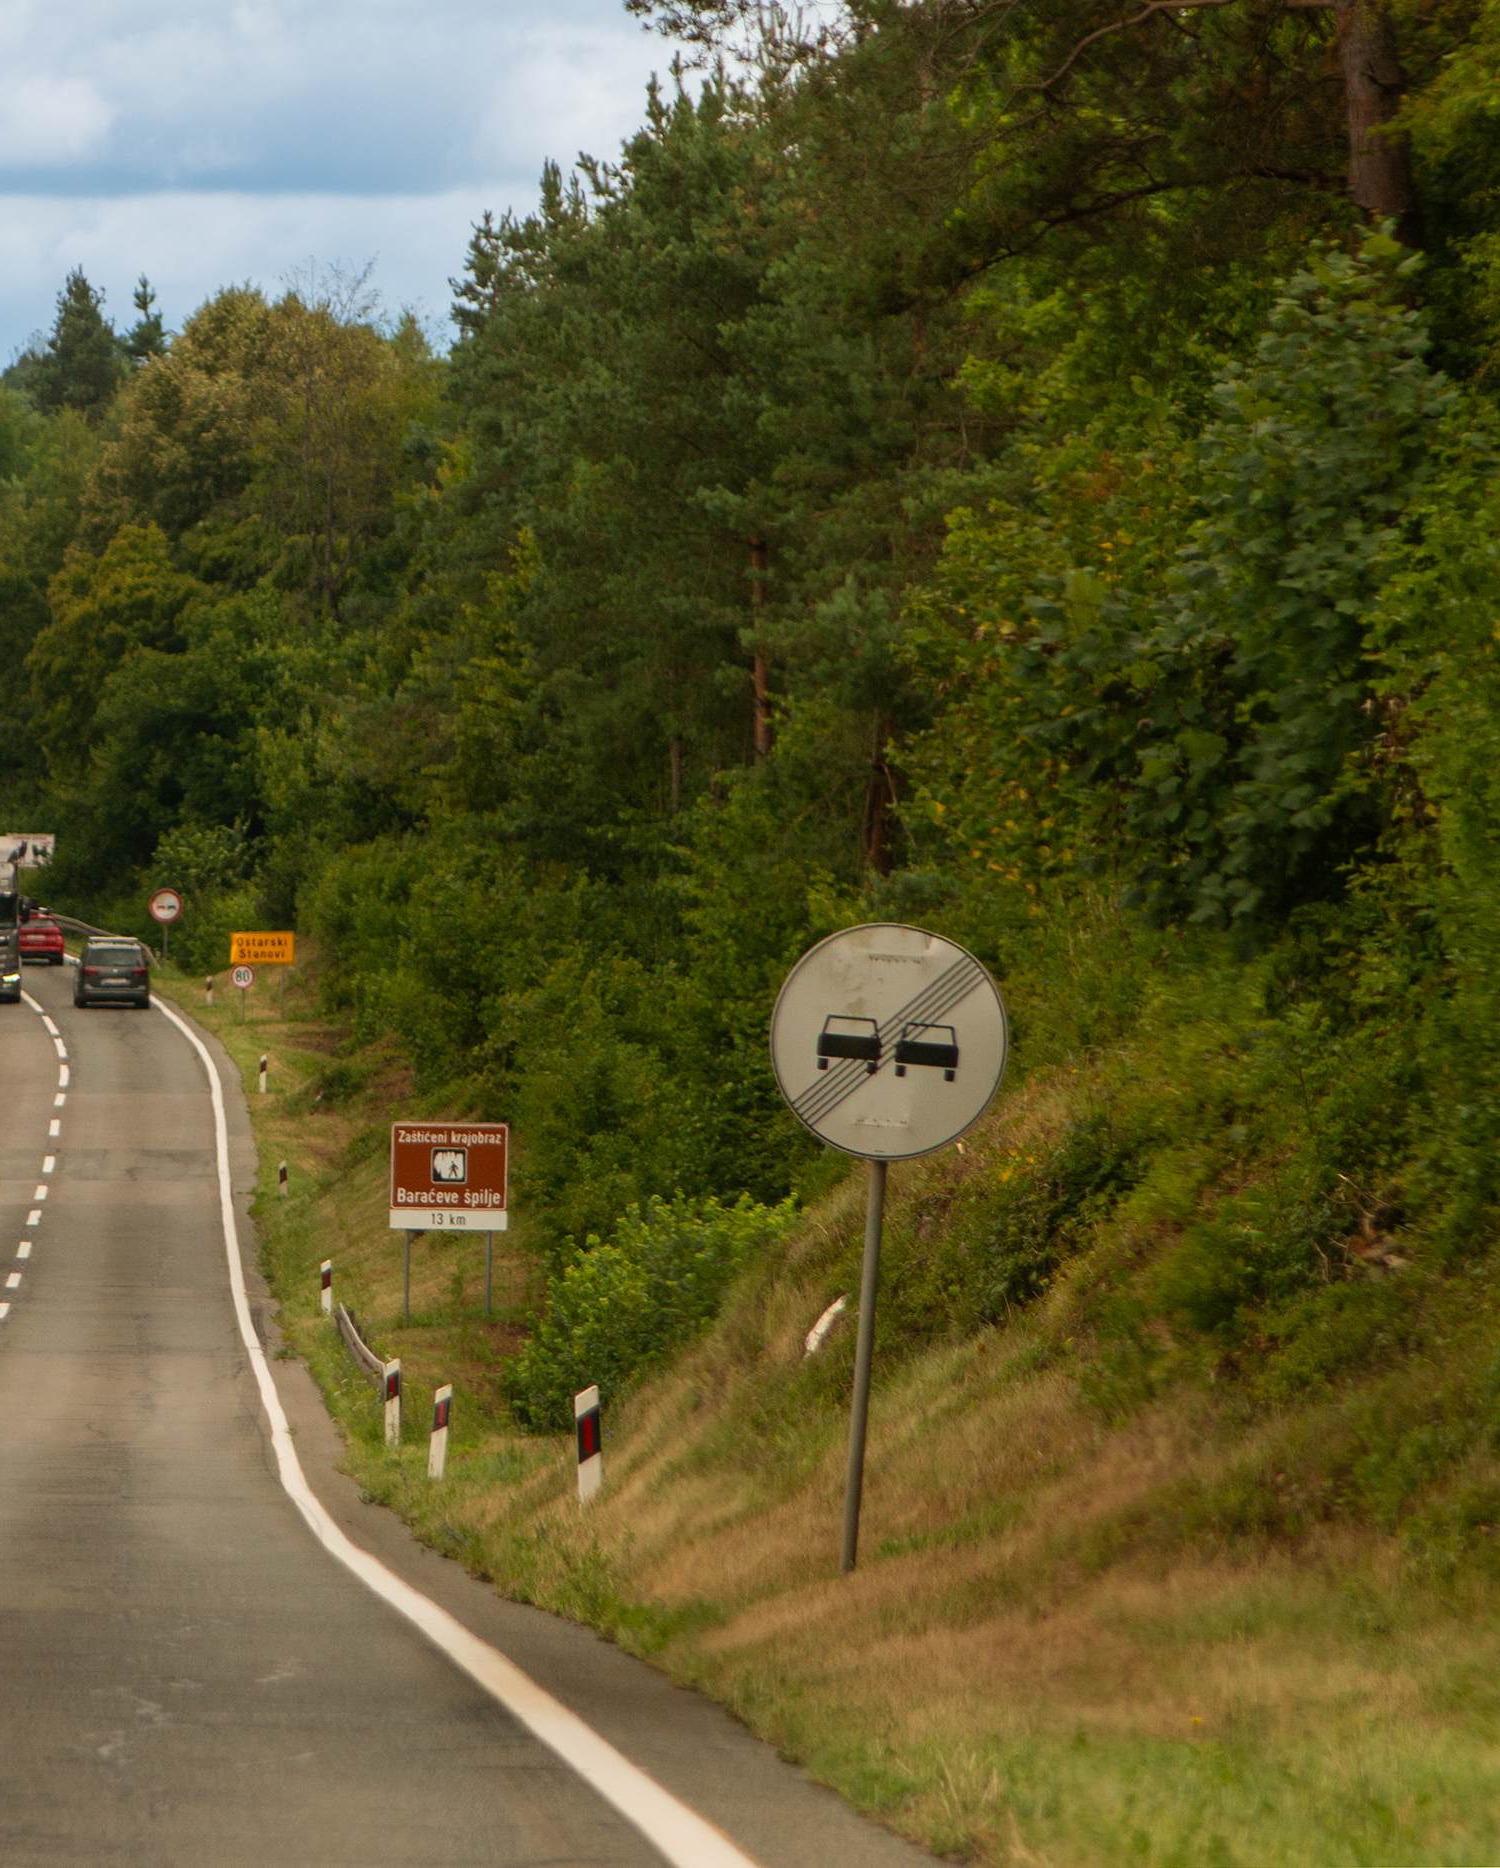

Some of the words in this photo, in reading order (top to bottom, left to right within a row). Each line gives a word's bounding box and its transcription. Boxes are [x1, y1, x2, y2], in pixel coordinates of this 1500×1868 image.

[239, 948, 285, 959] Stanovi
[235, 969, 250, 983] 80
[450, 1130, 503, 1147] krajobraz
[397, 1187, 460, 1204] Baraćeve
[463, 1188, 502, 1208] špilje
[431, 1213, 444, 1226] 13
[449, 1213, 466, 1226] km
